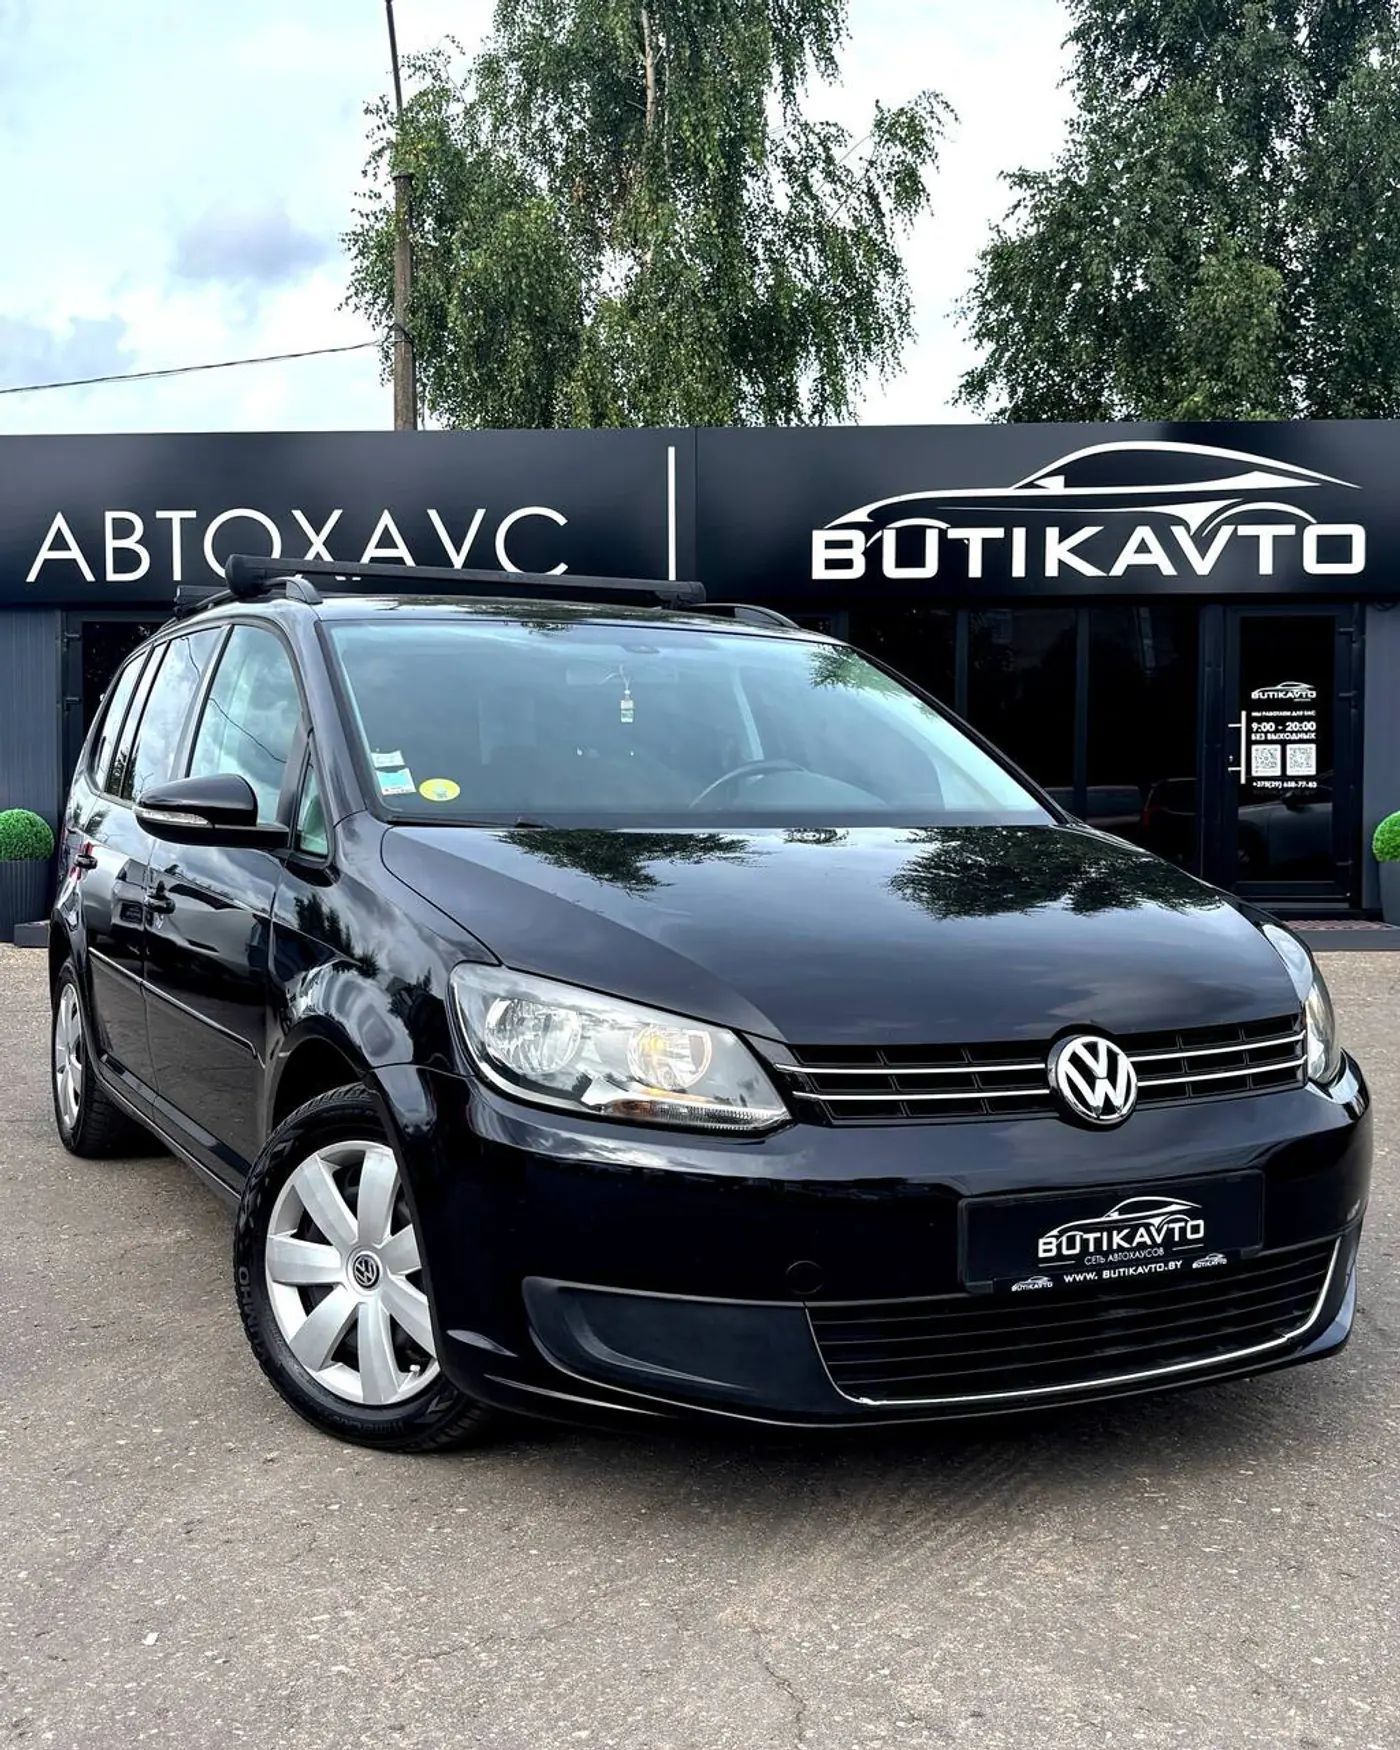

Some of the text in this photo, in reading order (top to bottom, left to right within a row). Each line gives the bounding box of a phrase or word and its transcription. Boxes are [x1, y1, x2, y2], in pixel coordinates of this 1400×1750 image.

[26, 505, 569, 583] АВТОХАУС
[811, 522, 1366, 580] BUTIKAVTO
[1251, 691, 1316, 699] BUTIKAVTO
[1251, 722, 1275, 732] 9:00
[1285, 721, 1316, 731] 20:00
[1038, 1219, 1205, 1258] BUTIKAVTO
[1084, 1247, 1165, 1266] СЕТЬ АВТОХАУСОВ
[1102, 1260, 1184, 1279] BUTIKAVTO.BY
